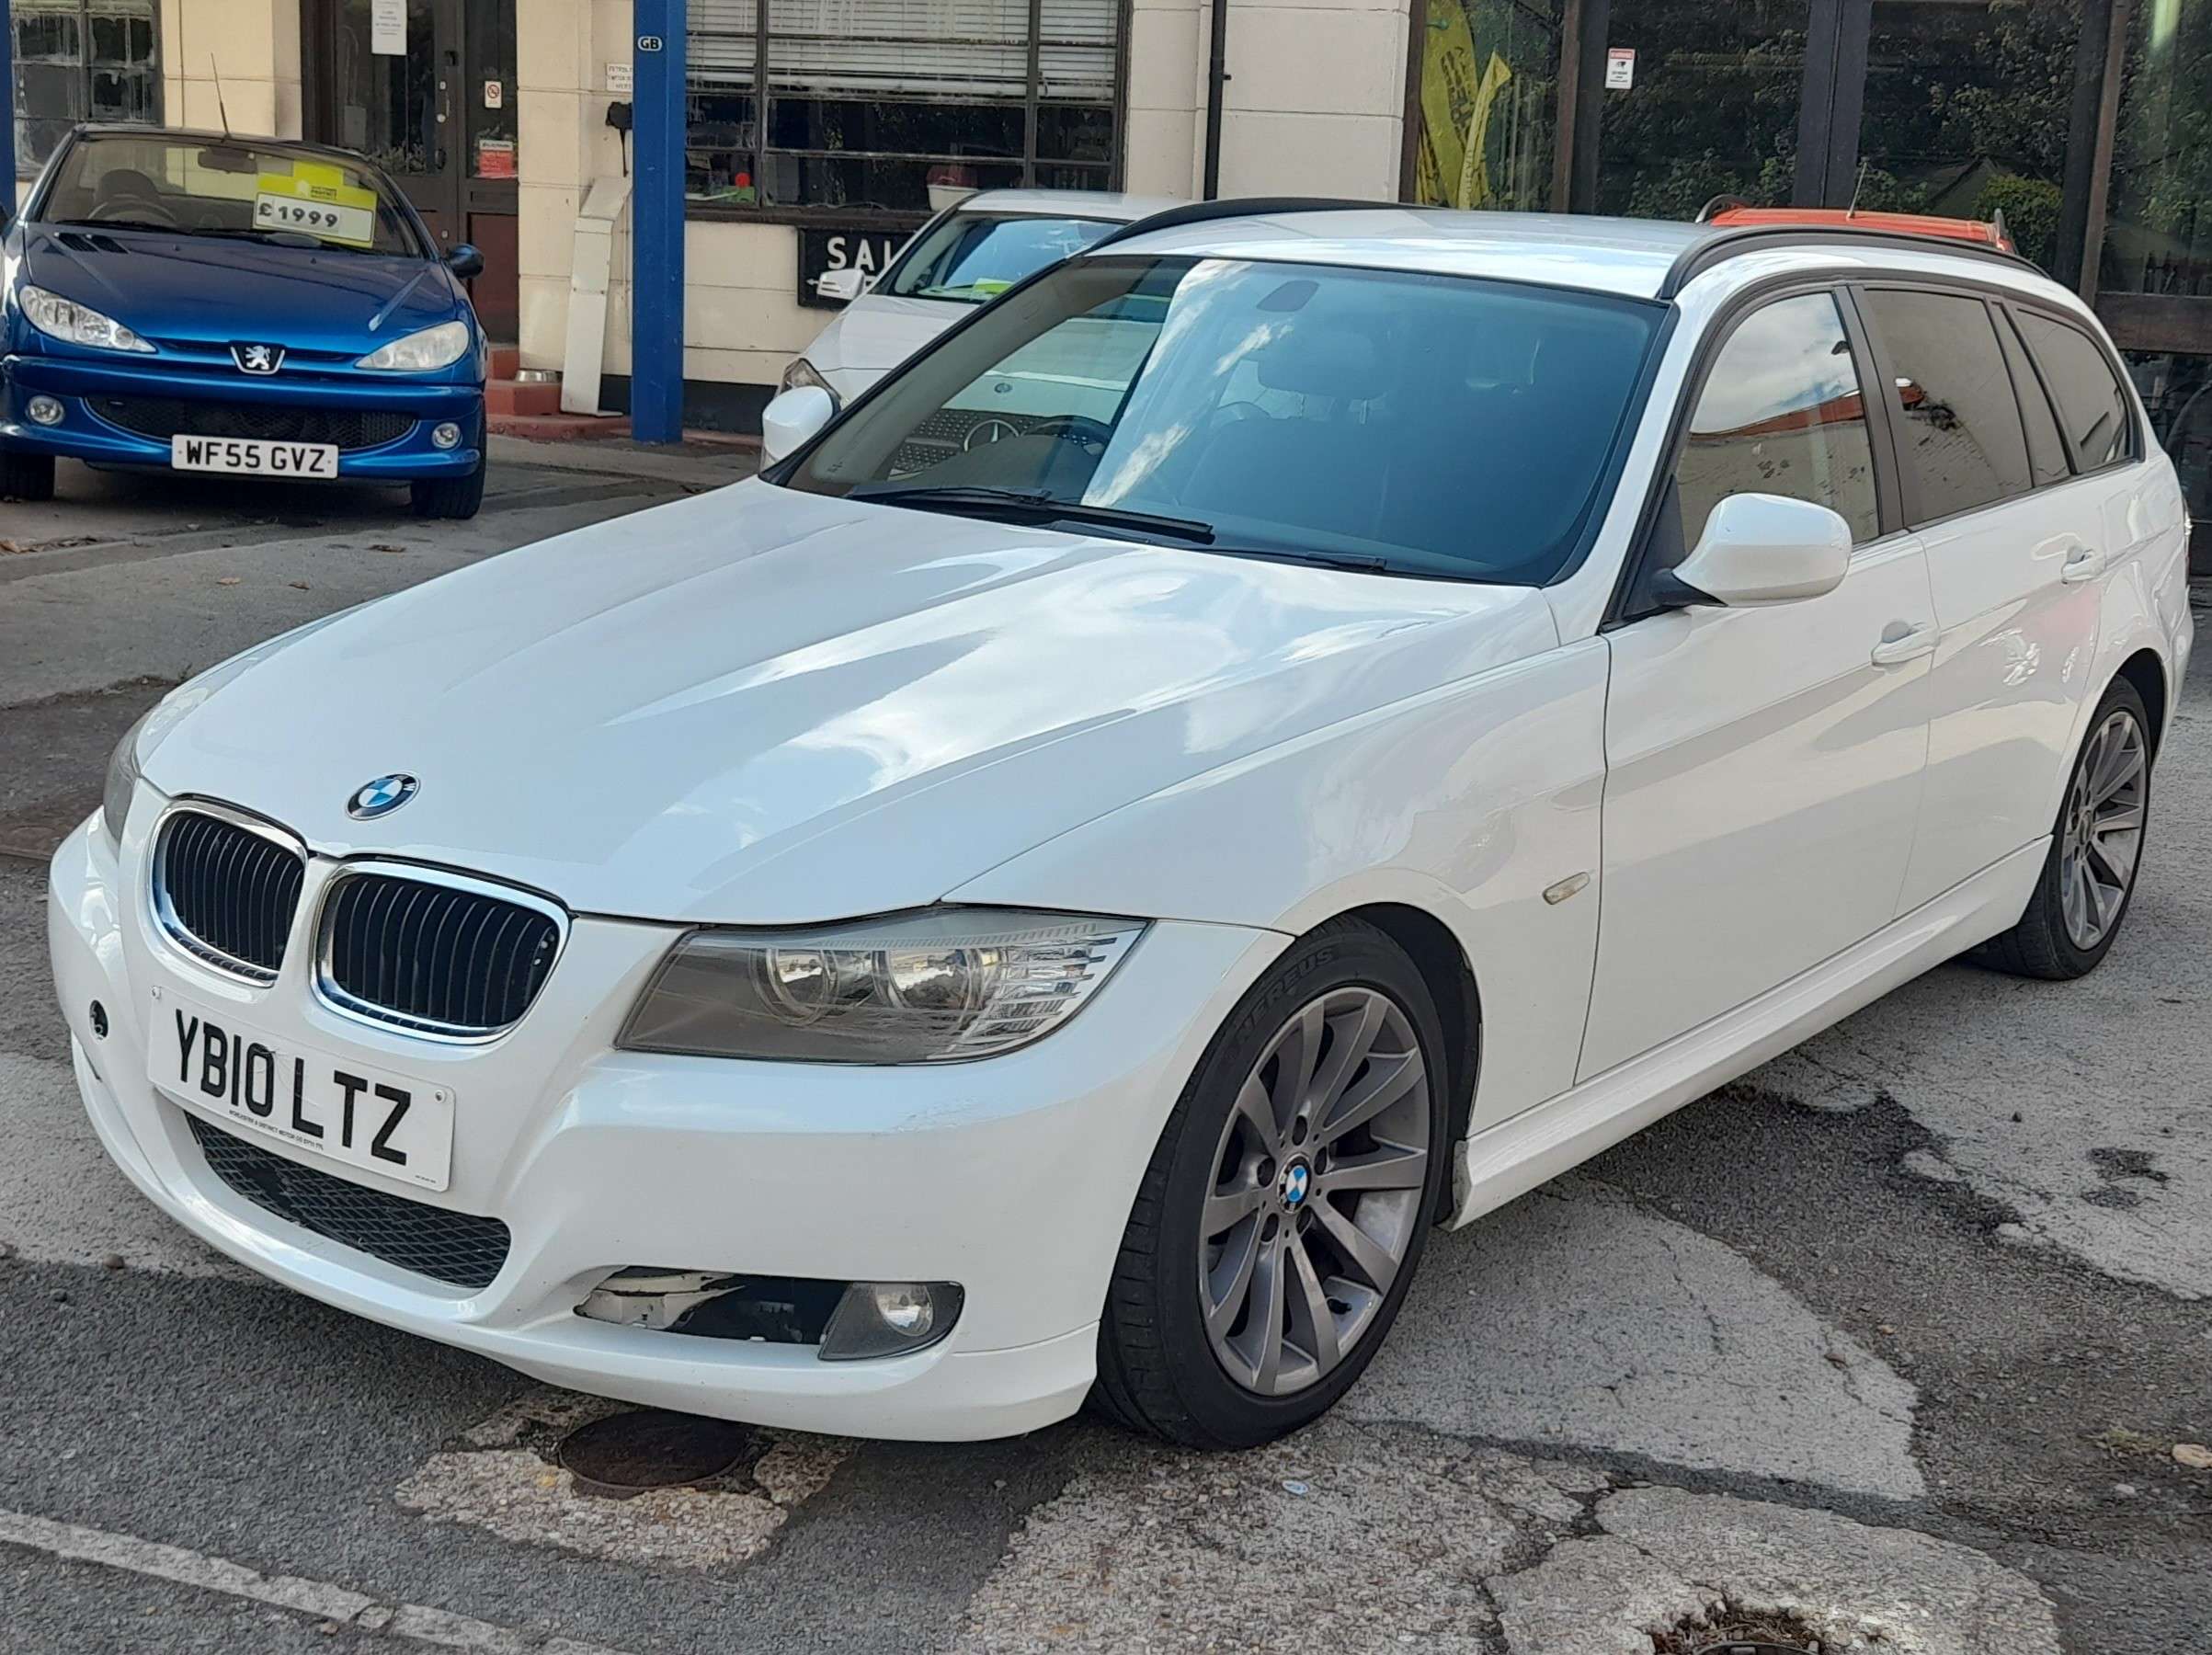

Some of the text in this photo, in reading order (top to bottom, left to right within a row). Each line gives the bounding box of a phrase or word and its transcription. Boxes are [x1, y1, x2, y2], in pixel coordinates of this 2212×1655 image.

[641, 38, 659, 50] GB
[258, 202, 338, 228] £1999
[187, 439, 325, 473] WF55 GVZ
[175, 1009, 411, 1166] YB10 LTZ
